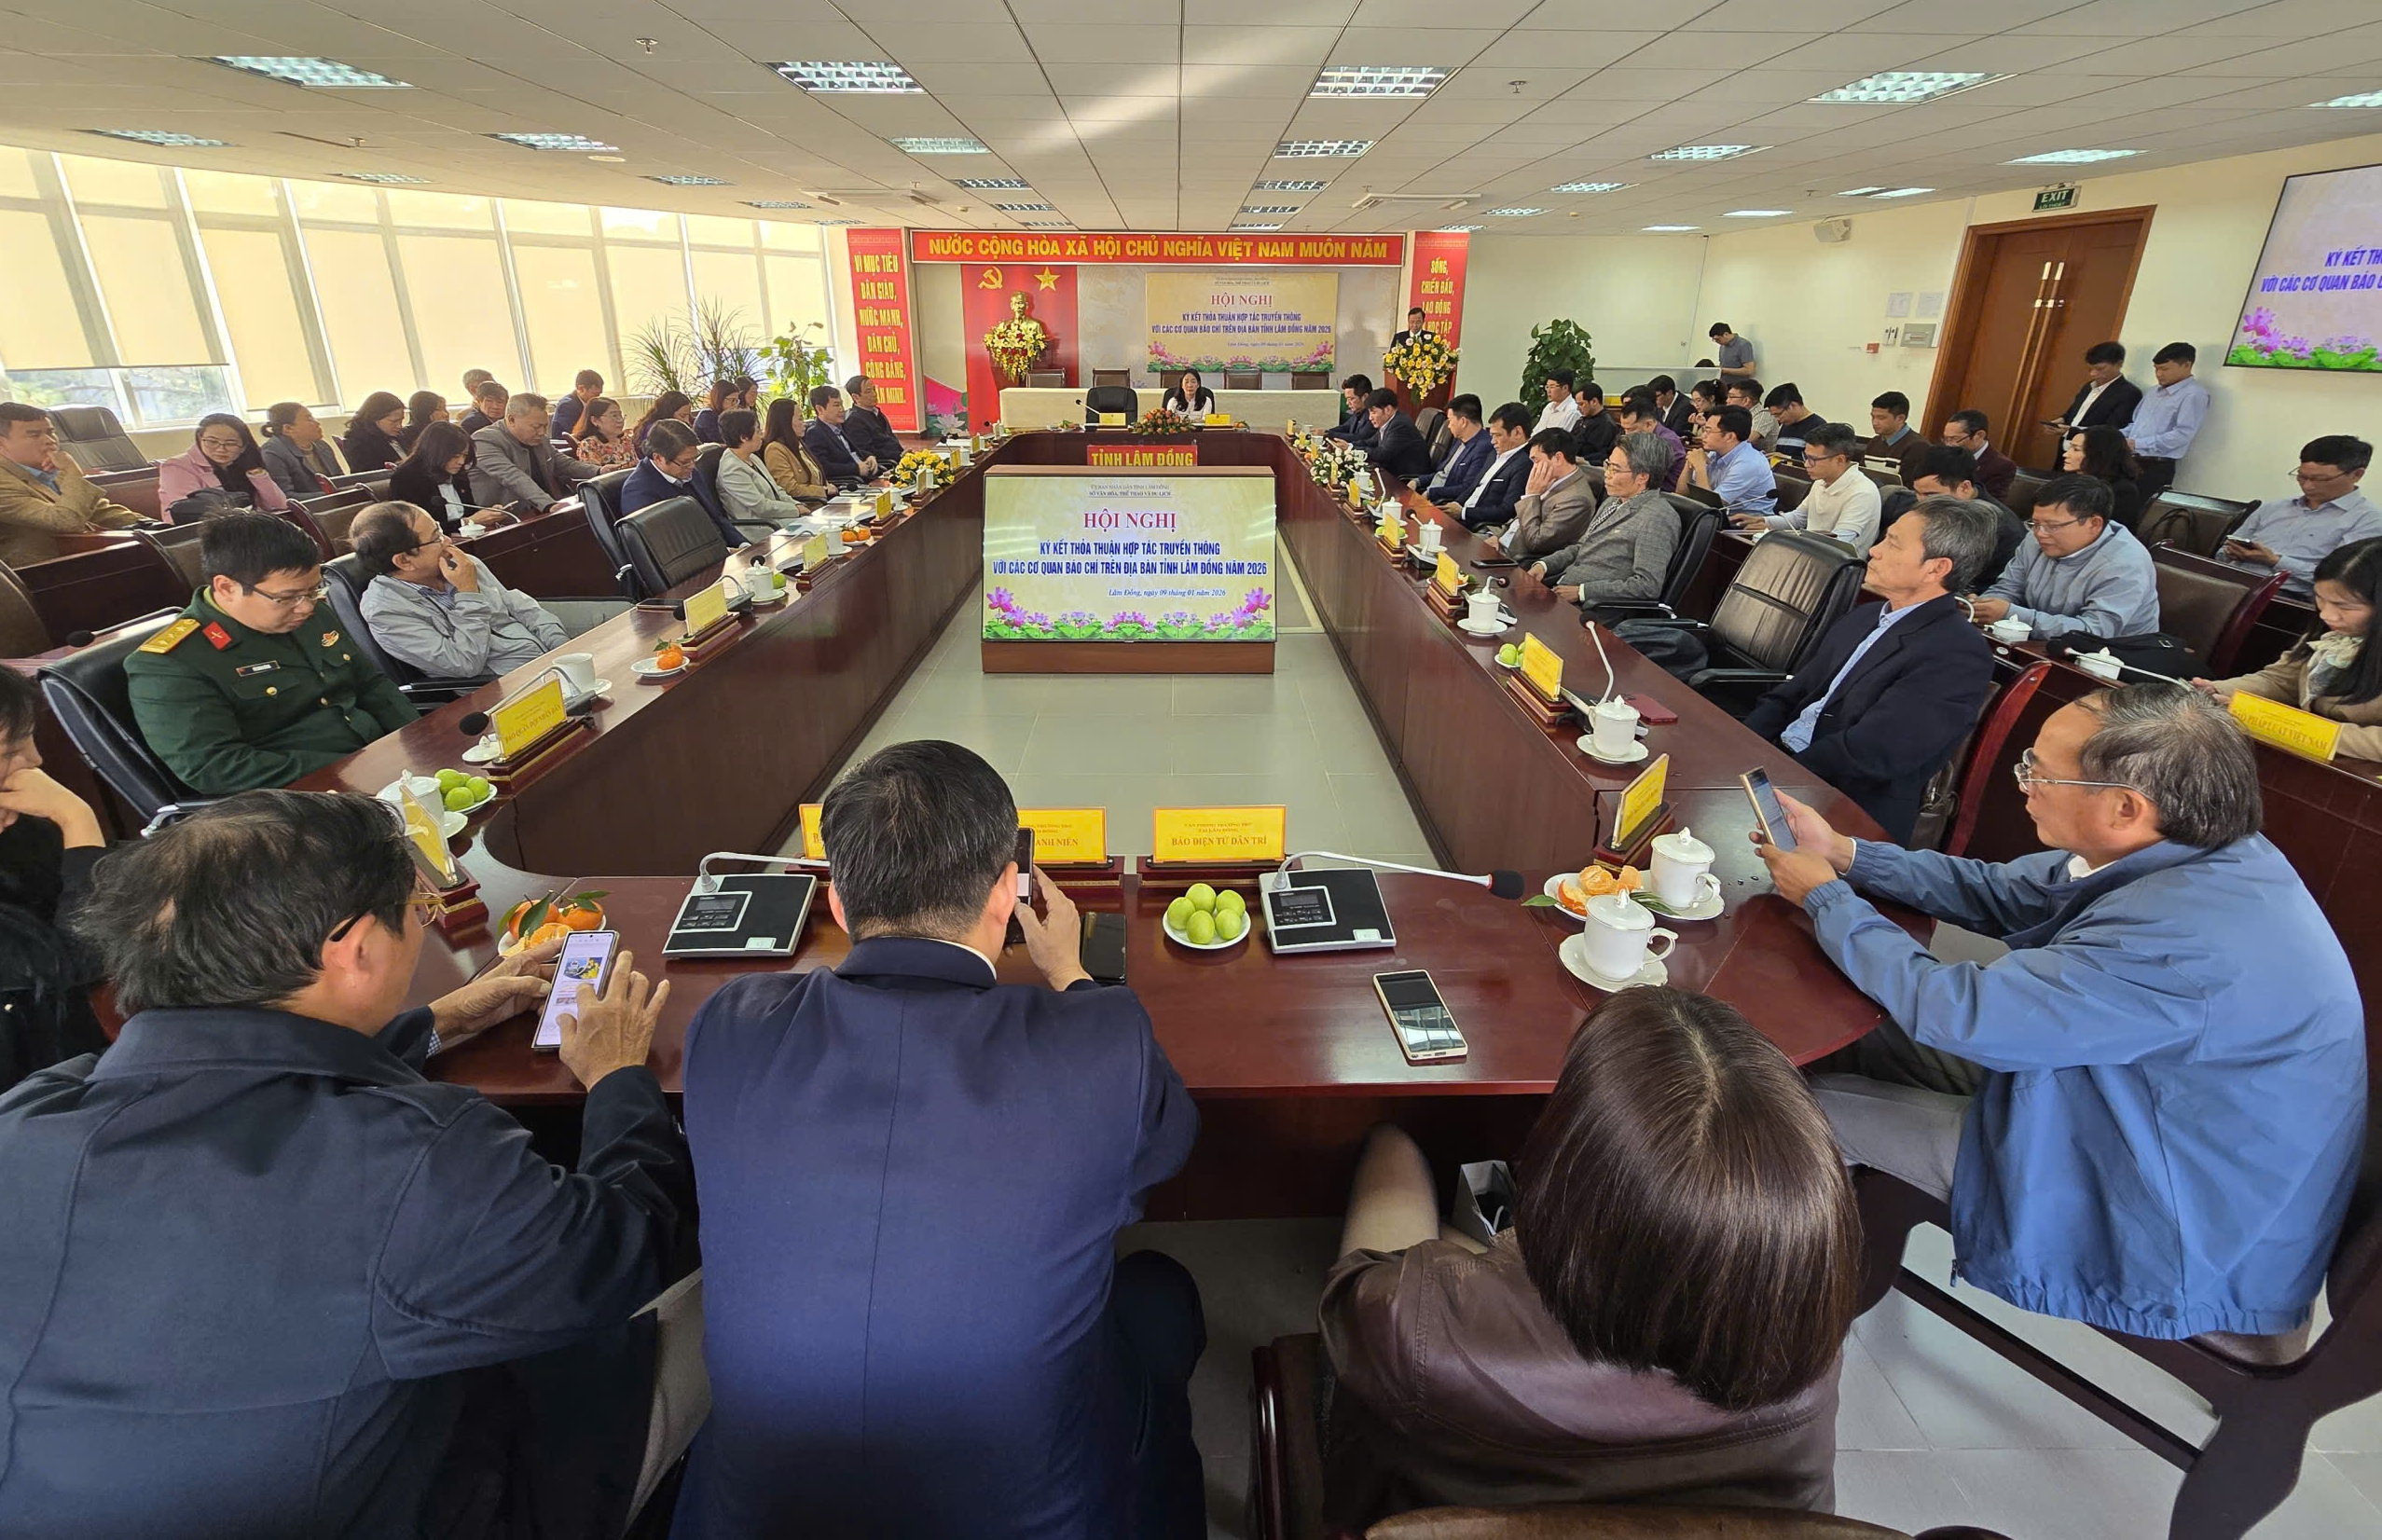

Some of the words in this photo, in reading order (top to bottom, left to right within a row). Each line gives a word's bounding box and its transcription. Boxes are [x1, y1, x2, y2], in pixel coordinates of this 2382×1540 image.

[2041, 190, 2069, 203] EXIT
[929, 234, 974, 255] NƯỚC
[978, 235, 1024, 260] CỘNG
[1027, 235, 1061, 256] HÒA
[1065, 236, 1089, 256] XÃ
[1093, 236, 1121, 260] HỘI
[1125, 235, 1159, 256] CHỦ
[1163, 236, 1213, 257] NGHĨA
[1217, 238, 1253, 261] VIỆT
[1258, 241, 1294, 257] NAM
[1299, 238, 1345, 257] MUÔN
[1351, 238, 1387, 257] NĂM
[2324, 248, 2343, 268] KÝ
[2341, 245, 2367, 267] KẾT
[2366, 248, 2382, 266] TH
[853, 251, 863, 273] VÌ
[863, 254, 881, 276] MỤC
[881, 251, 899, 273] TIÊU
[860, 279, 876, 300] DÂN
[1421, 278, 1439, 295] CHIẾN
[2260, 274, 2279, 292] VỚI
[2278, 273, 2301, 292] CÁC
[2301, 274, 2320, 292] CƠ
[2318, 275, 2351, 293] QUAN
[2349, 270, 2376, 290] BÁO
[1211, 292, 1235, 308] HỘI
[1239, 295, 1273, 308] NGHỊ
[1422, 301, 1434, 314] LAO
[1435, 298, 1452, 318] ĐỘNG
[859, 306, 879, 326] NƯỚC
[1440, 319, 1453, 337] TẬP
[866, 332, 883, 352] DÂN
[865, 359, 885, 378] CÔNG
[1092, 448, 1122, 466] TỈNH
[1125, 449, 1153, 466] LÂM
[1157, 447, 1193, 466] ĐỒNG
[1083, 508, 1120, 533] HỘI
[1126, 512, 1177, 533] NGHỊ
[1040, 539, 1050, 555] KÝ
[1053, 538, 1068, 555] KẾT
[1070, 538, 1092, 555] THỎA
[1093, 539, 1120, 557] THUẬN
[1122, 541, 1140, 557] HỢP
[1141, 540, 1157, 555] TÁC
[1159, 539, 1191, 556] TRUYỀN
[1192, 540, 1220, 556] THÔNG
[993, 559, 1007, 574] VỚI
[1009, 558, 1026, 574] CÁC
[1027, 560, 1040, 574] CƠ
[1040, 561, 1063, 575] QUAN
[1065, 559, 1082, 574] BÁO
[1084, 558, 1098, 574] CHÍ
[1100, 558, 1122, 574] TRÊN
[1123, 561, 1138, 577] ĐỊA
[1139, 558, 1157, 574] BÀN
[1159, 557, 1178, 574] TỈNH
[1180, 559, 1199, 574] LÂM
[1200, 557, 1223, 575] ĐỒNG
[1225, 559, 1245, 575] NĂM
[1246, 562, 1267, 575] 2026
[1108, 588, 1122, 597] Lâm
[1123, 588, 1142, 598] Đồng,
[1143, 589, 1158, 598] ngày
[1168, 588, 1186, 598] tháng
[1035, 838, 1054, 846] ANH
[1055, 836, 1079, 846] NIÊN
[1171, 835, 1191, 846] BÁO
[1192, 835, 1214, 847] ĐIỆN
[1216, 835, 1230, 846] TỬ
[1230, 834, 1250, 846] DÂN
[1250, 833, 1267, 846] TRÍ
